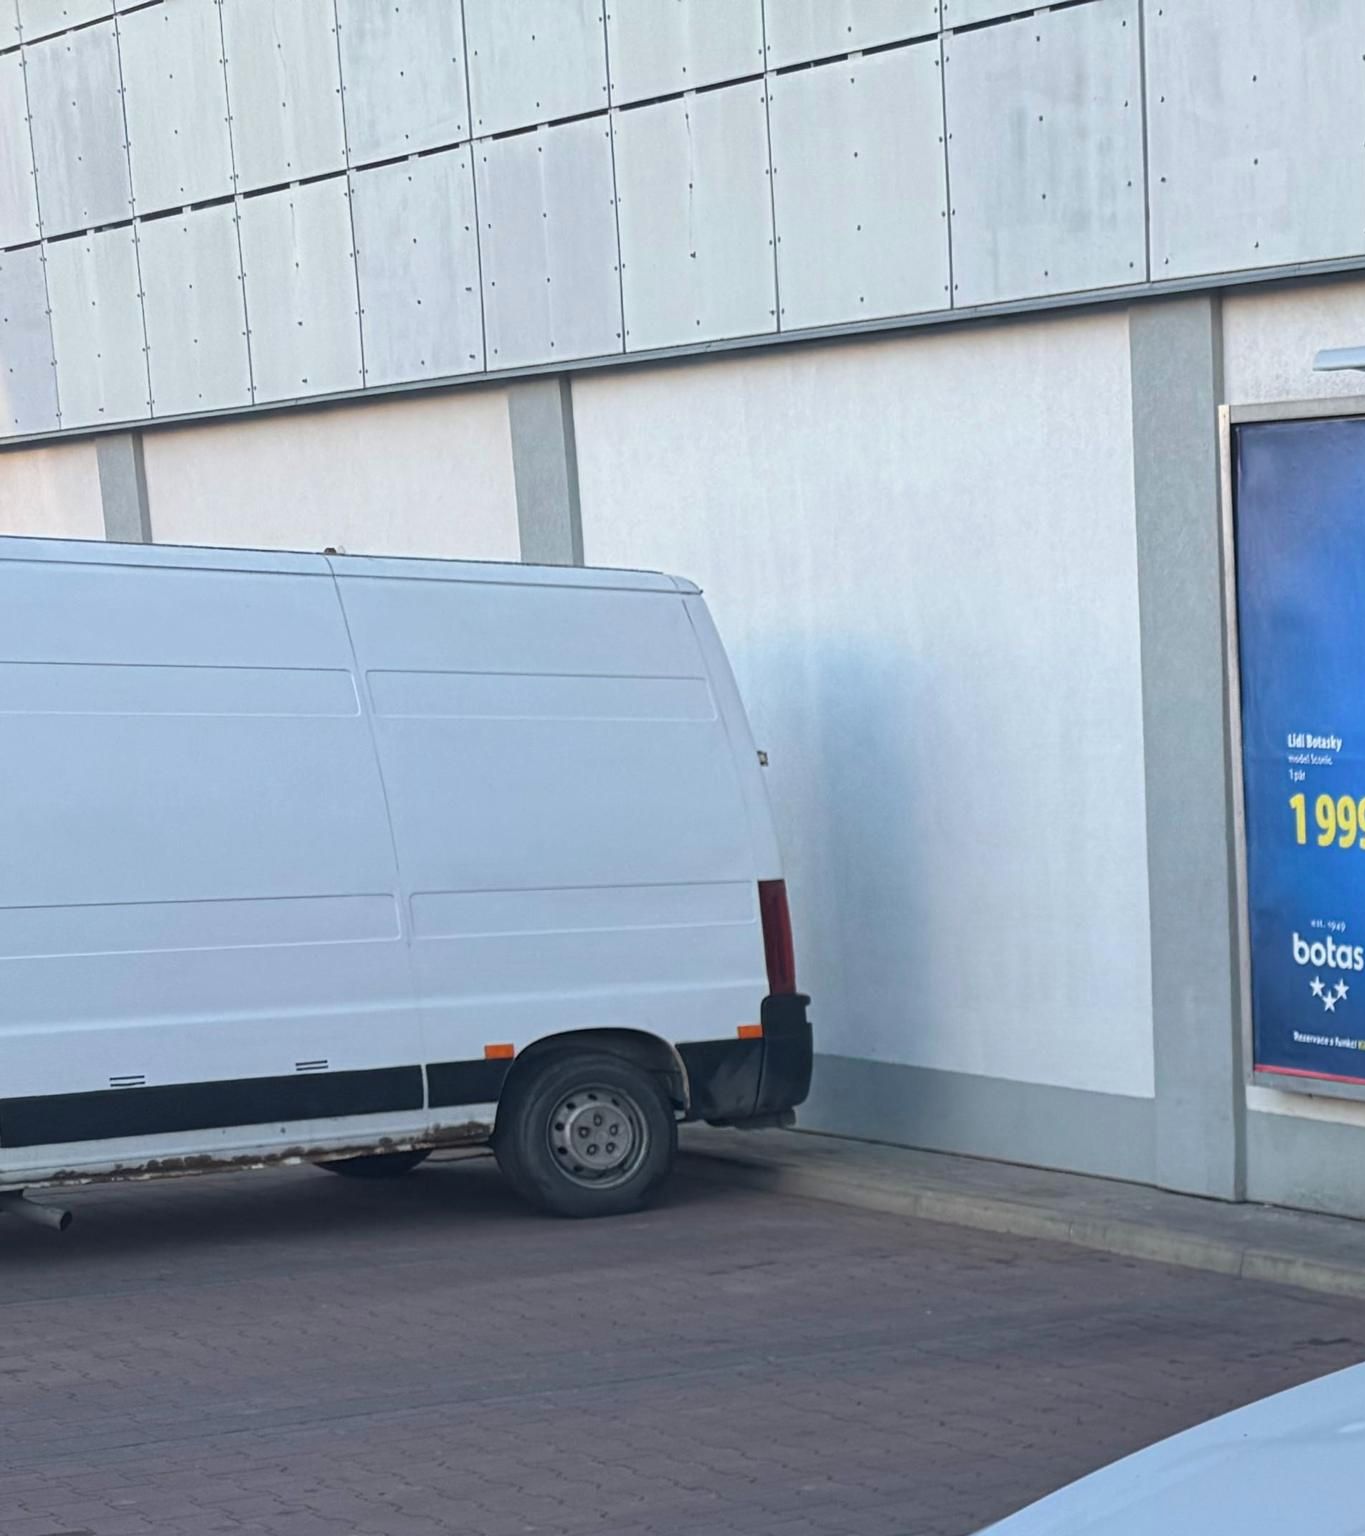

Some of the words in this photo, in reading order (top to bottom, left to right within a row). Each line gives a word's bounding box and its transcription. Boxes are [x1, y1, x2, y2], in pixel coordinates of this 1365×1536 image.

[1287, 733, 1305, 749] Lidl
[1306, 733, 1343, 752] Botasky
[1289, 793, 1306, 845] 1
[1292, 931, 1365, 972] botas
